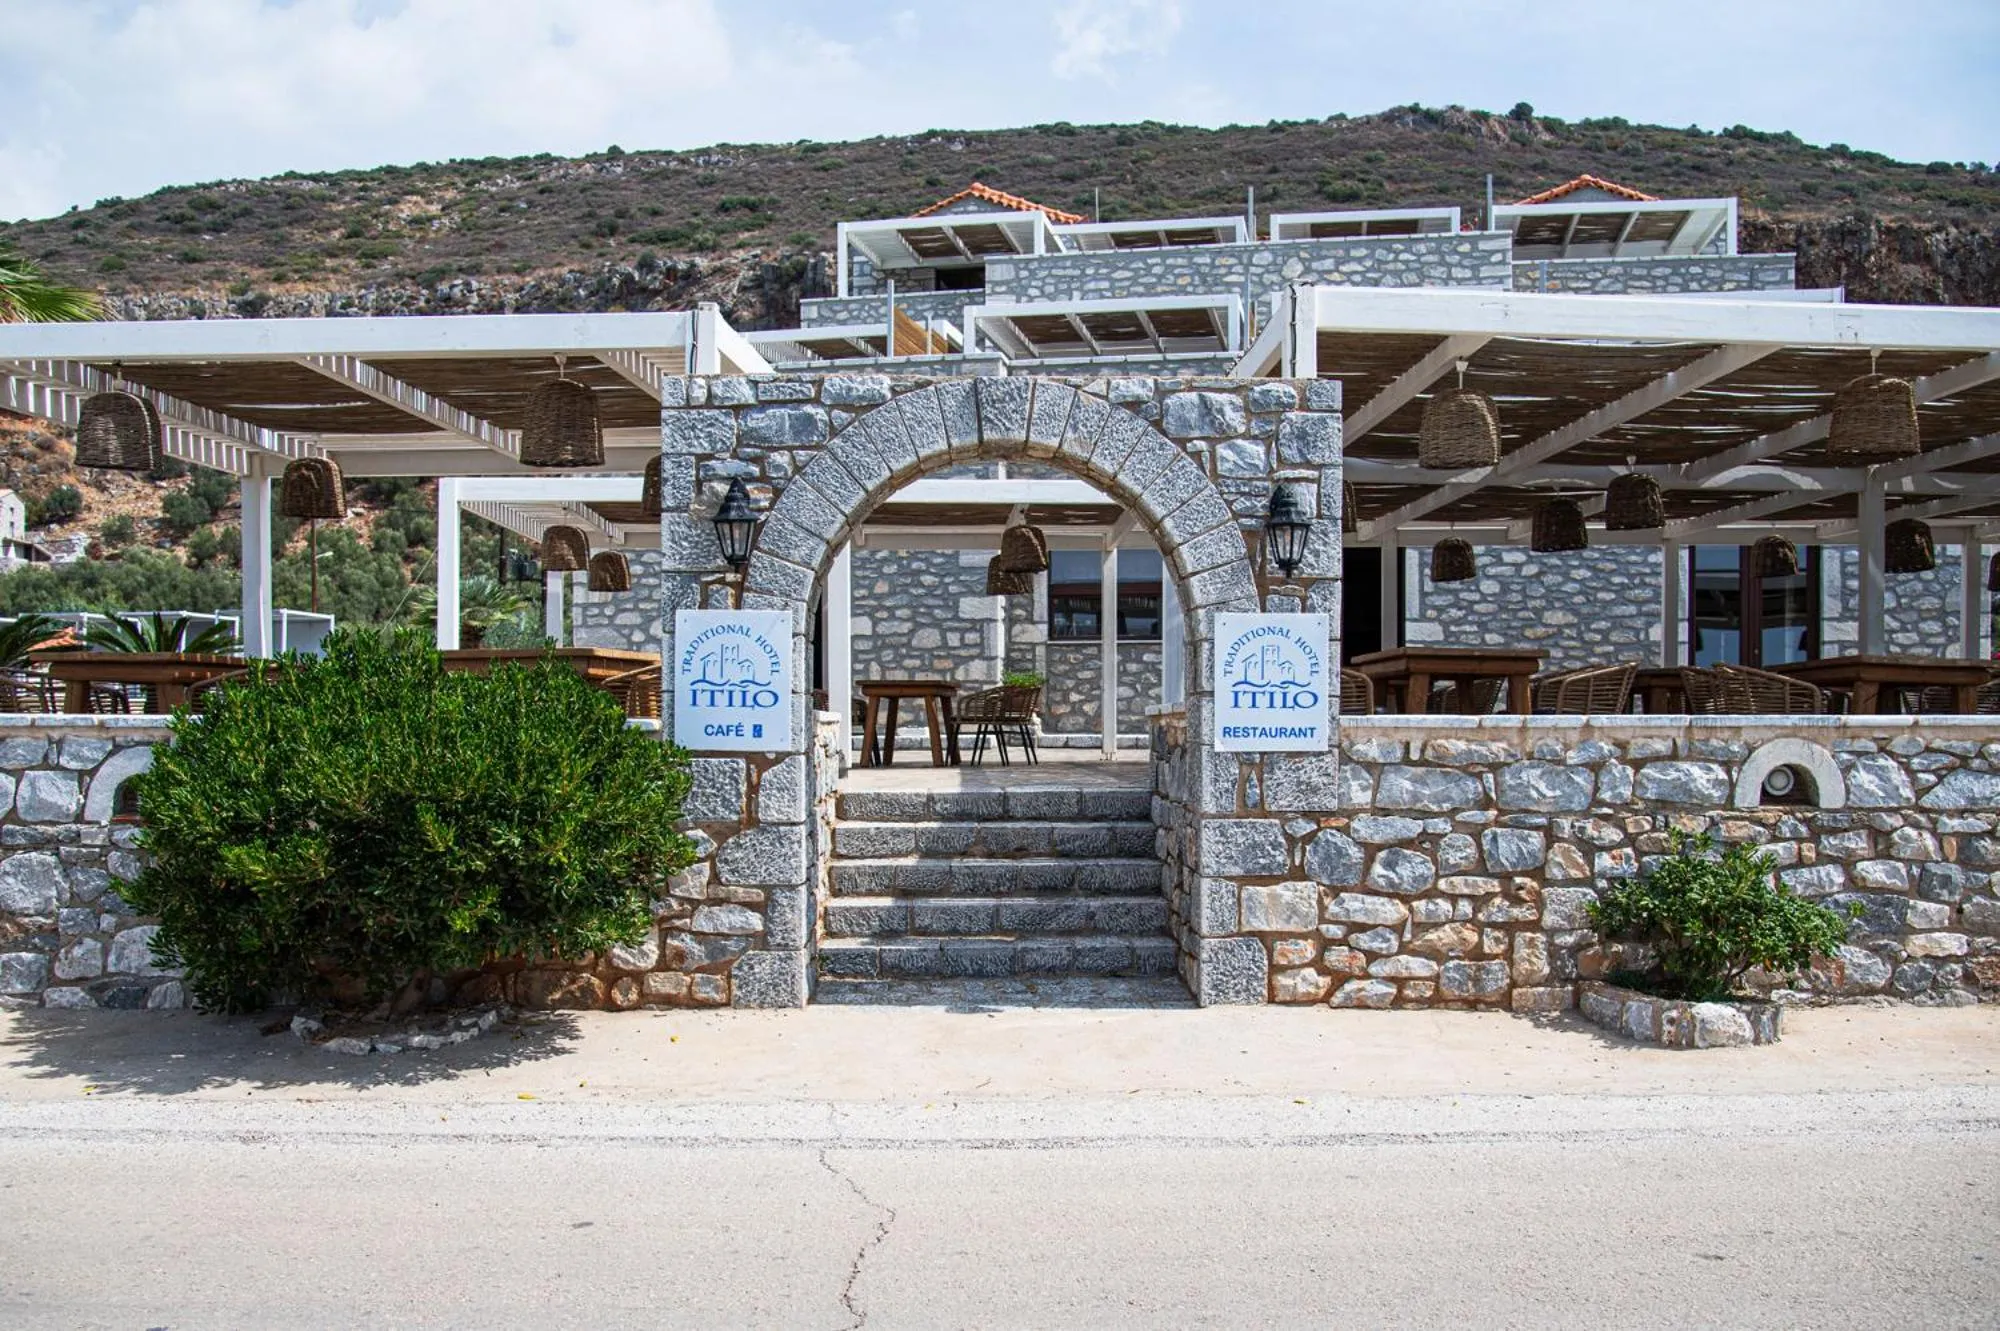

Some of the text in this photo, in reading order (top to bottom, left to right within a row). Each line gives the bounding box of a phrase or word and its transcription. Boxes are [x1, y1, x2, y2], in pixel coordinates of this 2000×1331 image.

[682, 624, 781, 676] TRADITIONAL HOTEL
[1223, 626, 1319, 677] TRADITIONAL HOTEL
[690, 689, 779, 710] ITILO
[1230, 690, 1319, 710] ITILO
[704, 722, 745, 737] CAFÉ
[1223, 726, 1317, 738] RESTAURANT
